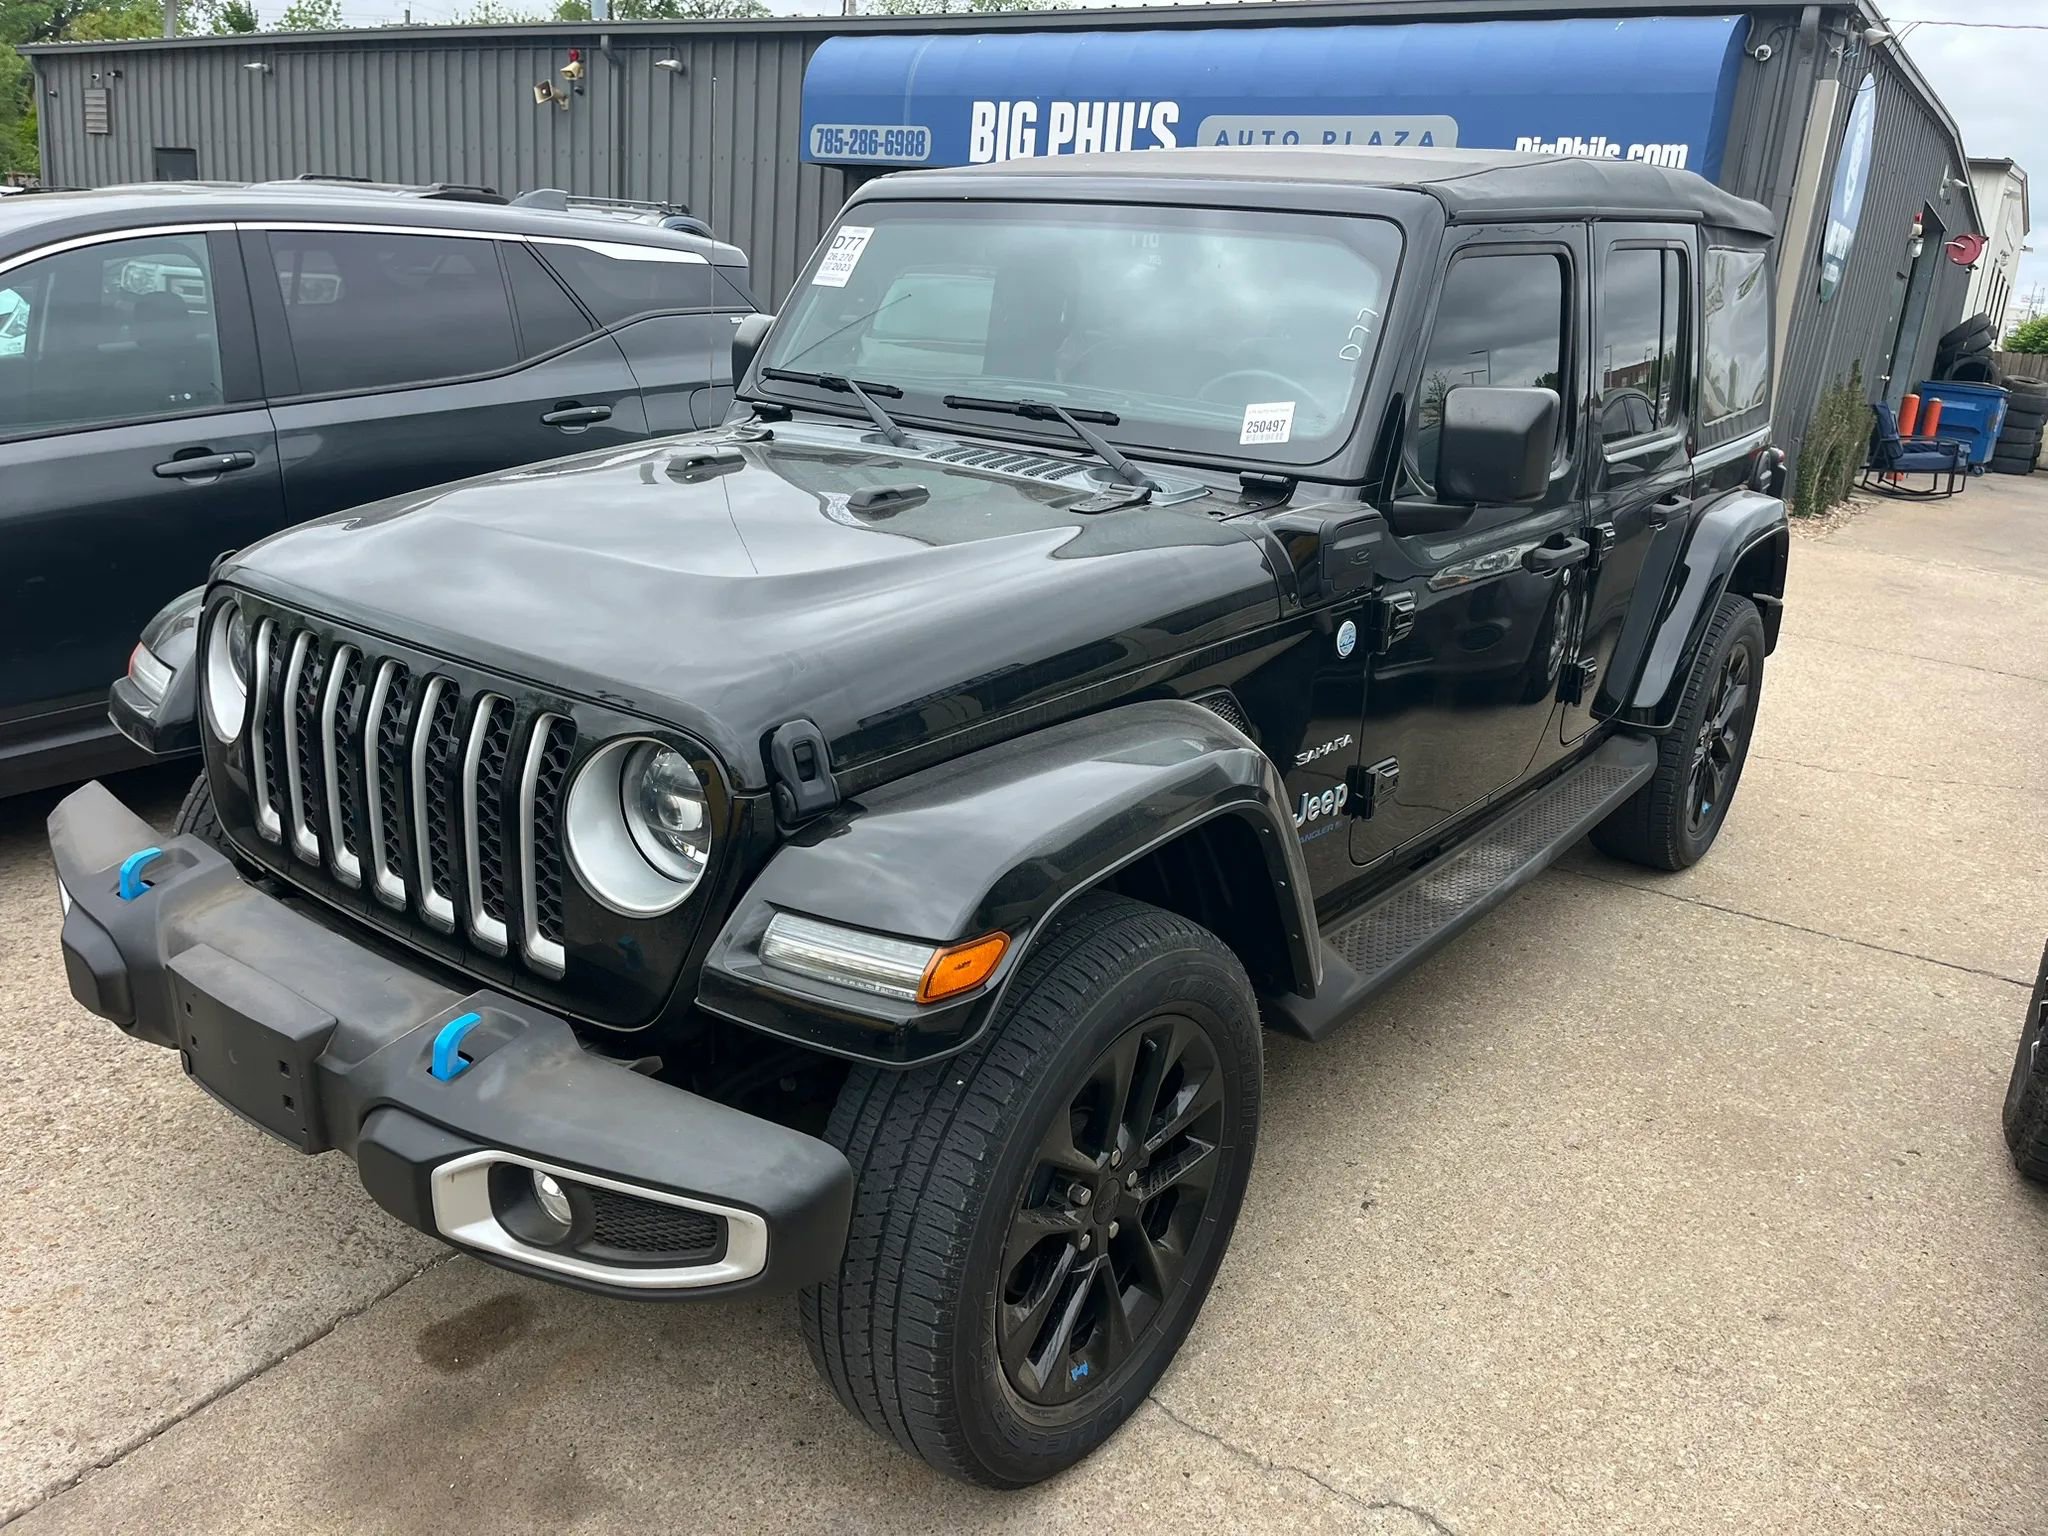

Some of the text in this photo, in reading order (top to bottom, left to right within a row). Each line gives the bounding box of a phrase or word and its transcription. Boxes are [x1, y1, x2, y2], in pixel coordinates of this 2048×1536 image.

[816, 128, 926, 157] 785-286-6988
[969, 101, 1180, 163] BIG PHIL'S
[1214, 130, 1435, 147] AUTO PLAZA
[1514, 136, 1689, 170] iPhilscom
[832, 235, 865, 251] D77
[1338, 307, 1380, 361] D77
[1246, 419, 1287, 434] 250497
[1295, 734, 1353, 766] SAHARA
[1292, 783, 1348, 828] Jeep
[1297, 823, 1335, 844] ANGLER
